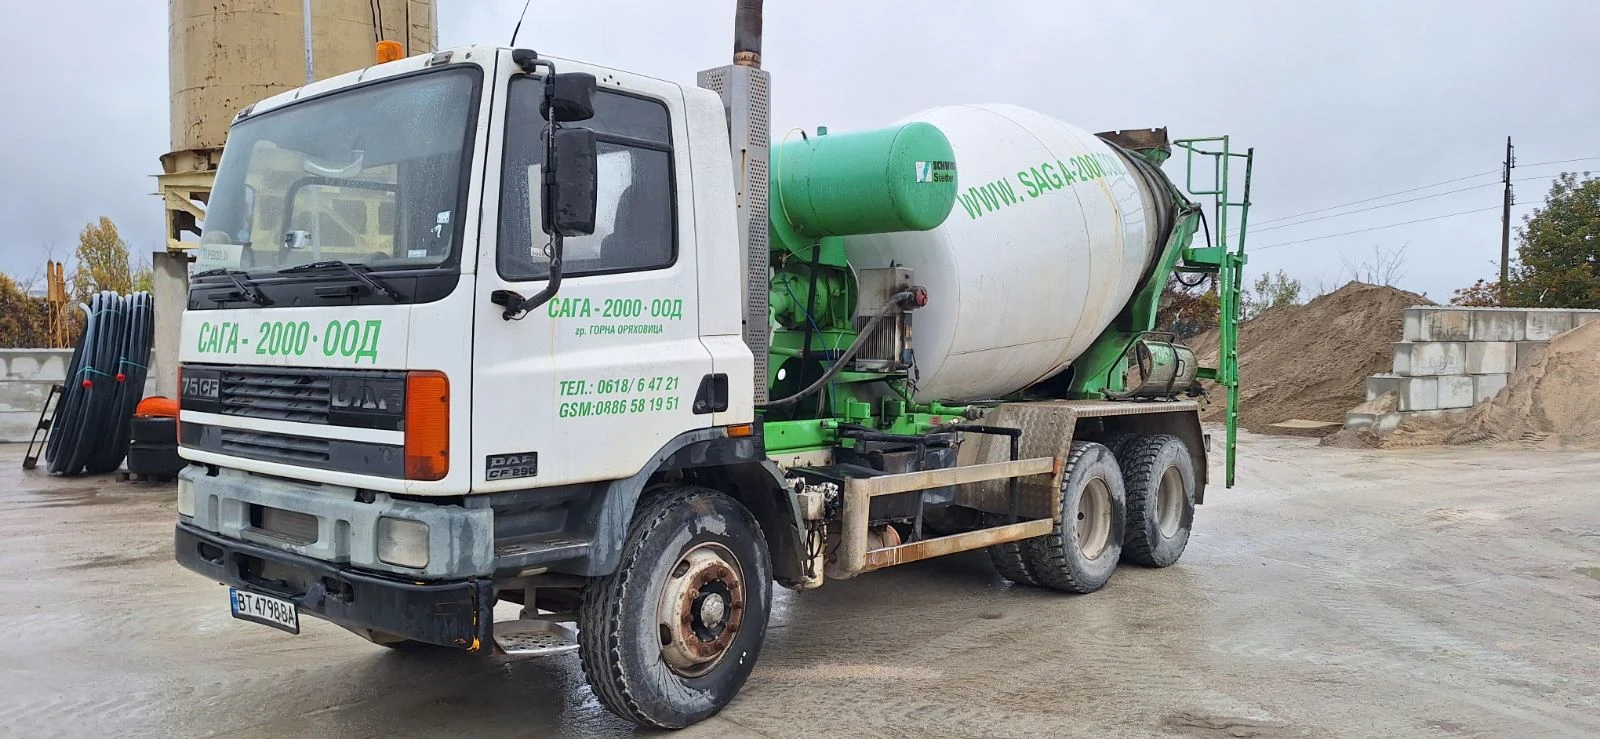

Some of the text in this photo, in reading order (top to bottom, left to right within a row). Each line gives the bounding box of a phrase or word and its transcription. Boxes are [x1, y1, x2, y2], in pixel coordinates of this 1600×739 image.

[548, 297, 591, 318] САГА
[603, 298, 642, 318] 2000
[651, 298, 683, 321] ООД
[575, 324, 663, 337] гр. ГОРНА ОРЯХОВИЦА
[197, 321, 239, 354] САГА
[255, 321, 310, 356] 2000
[323, 319, 382, 364] ООД
[183, 377, 219, 397] 75 CF
[559, 376, 679, 396] ТЕЛ.: 0618/ 6 47 21
[630, 398, 646, 413] 58
[650, 397, 663, 411] 19
[666, 396, 679, 410] 51
[488, 469, 510, 478] CF
